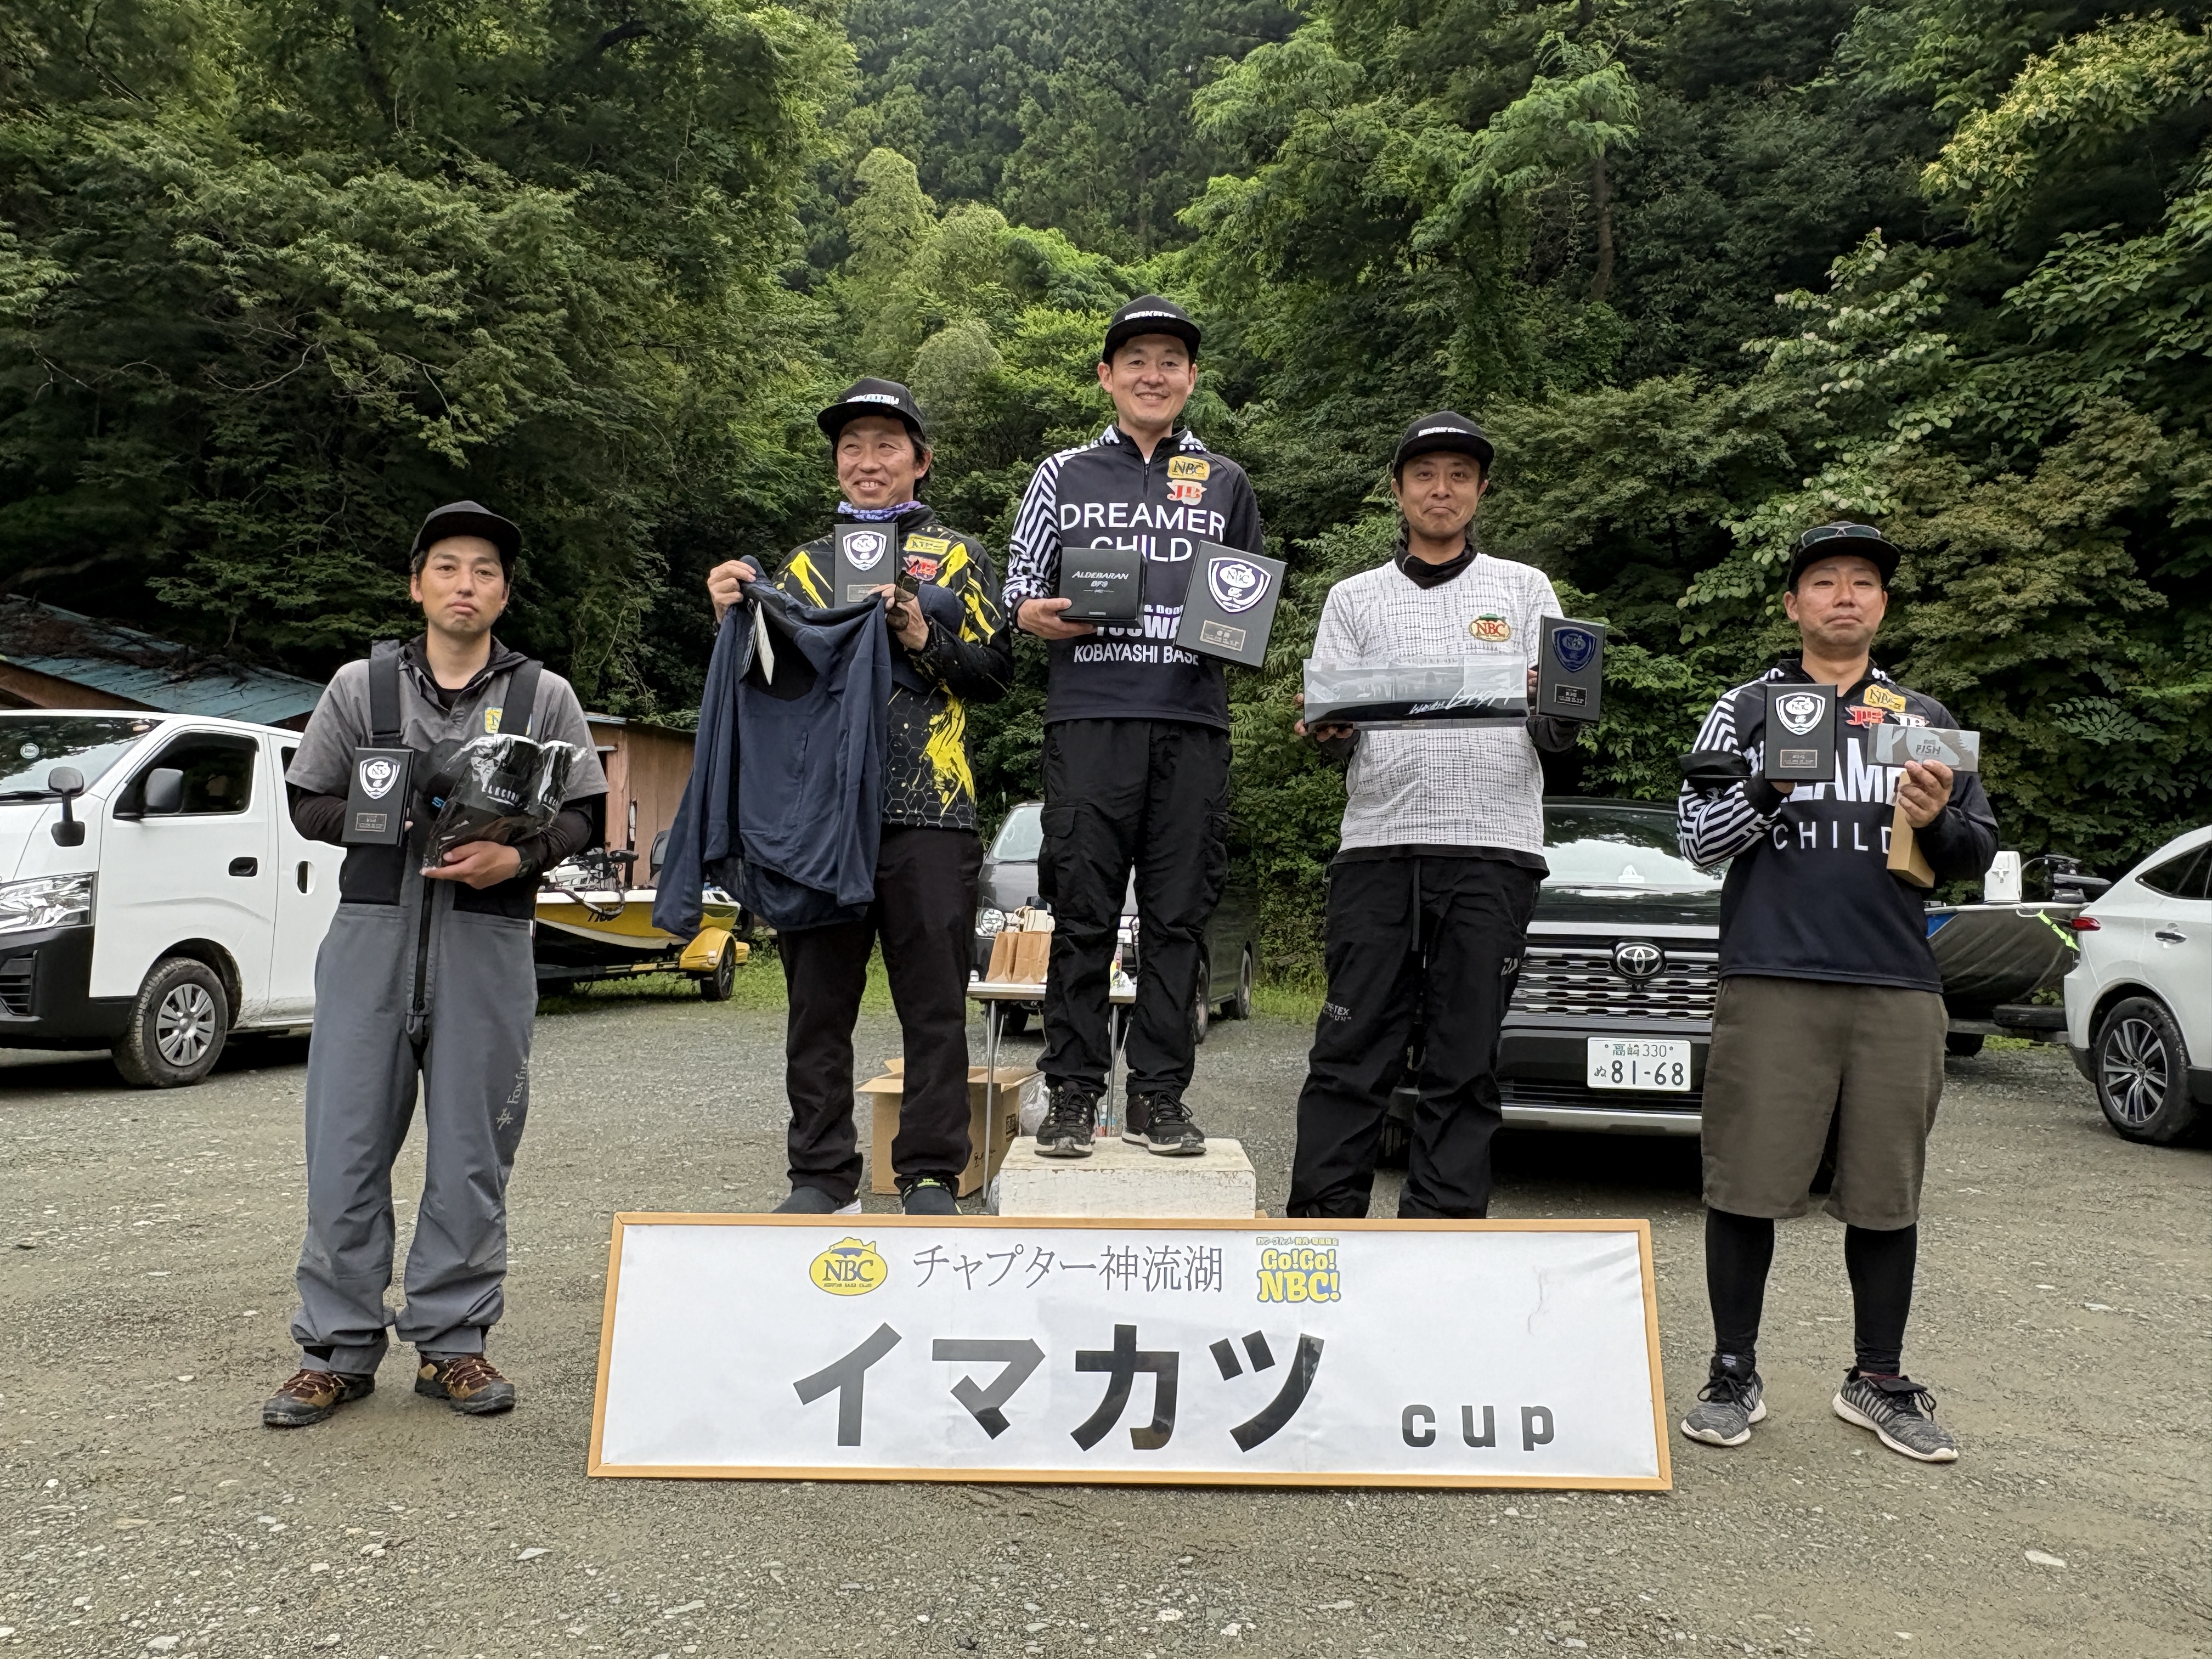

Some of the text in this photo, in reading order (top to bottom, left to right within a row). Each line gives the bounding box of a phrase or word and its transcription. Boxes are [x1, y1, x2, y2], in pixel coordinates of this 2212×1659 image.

[1060, 503, 1226, 543] DREAMER
[1071, 571, 1130, 580] ALDEBARAN
[1473, 621, 1506, 637] NBC
[1073, 643, 1158, 663] KOBAYASHI
[1642, 1043, 1667, 1058] 330
[1611, 1059, 1684, 1086] 81-68
[822, 1259, 874, 1282] NBC
[913, 1244, 1223, 1293] チャプター神流湖
[1256, 1270, 1341, 1303] NBC!
[792, 1321, 1555, 1453] イマカツ cup
